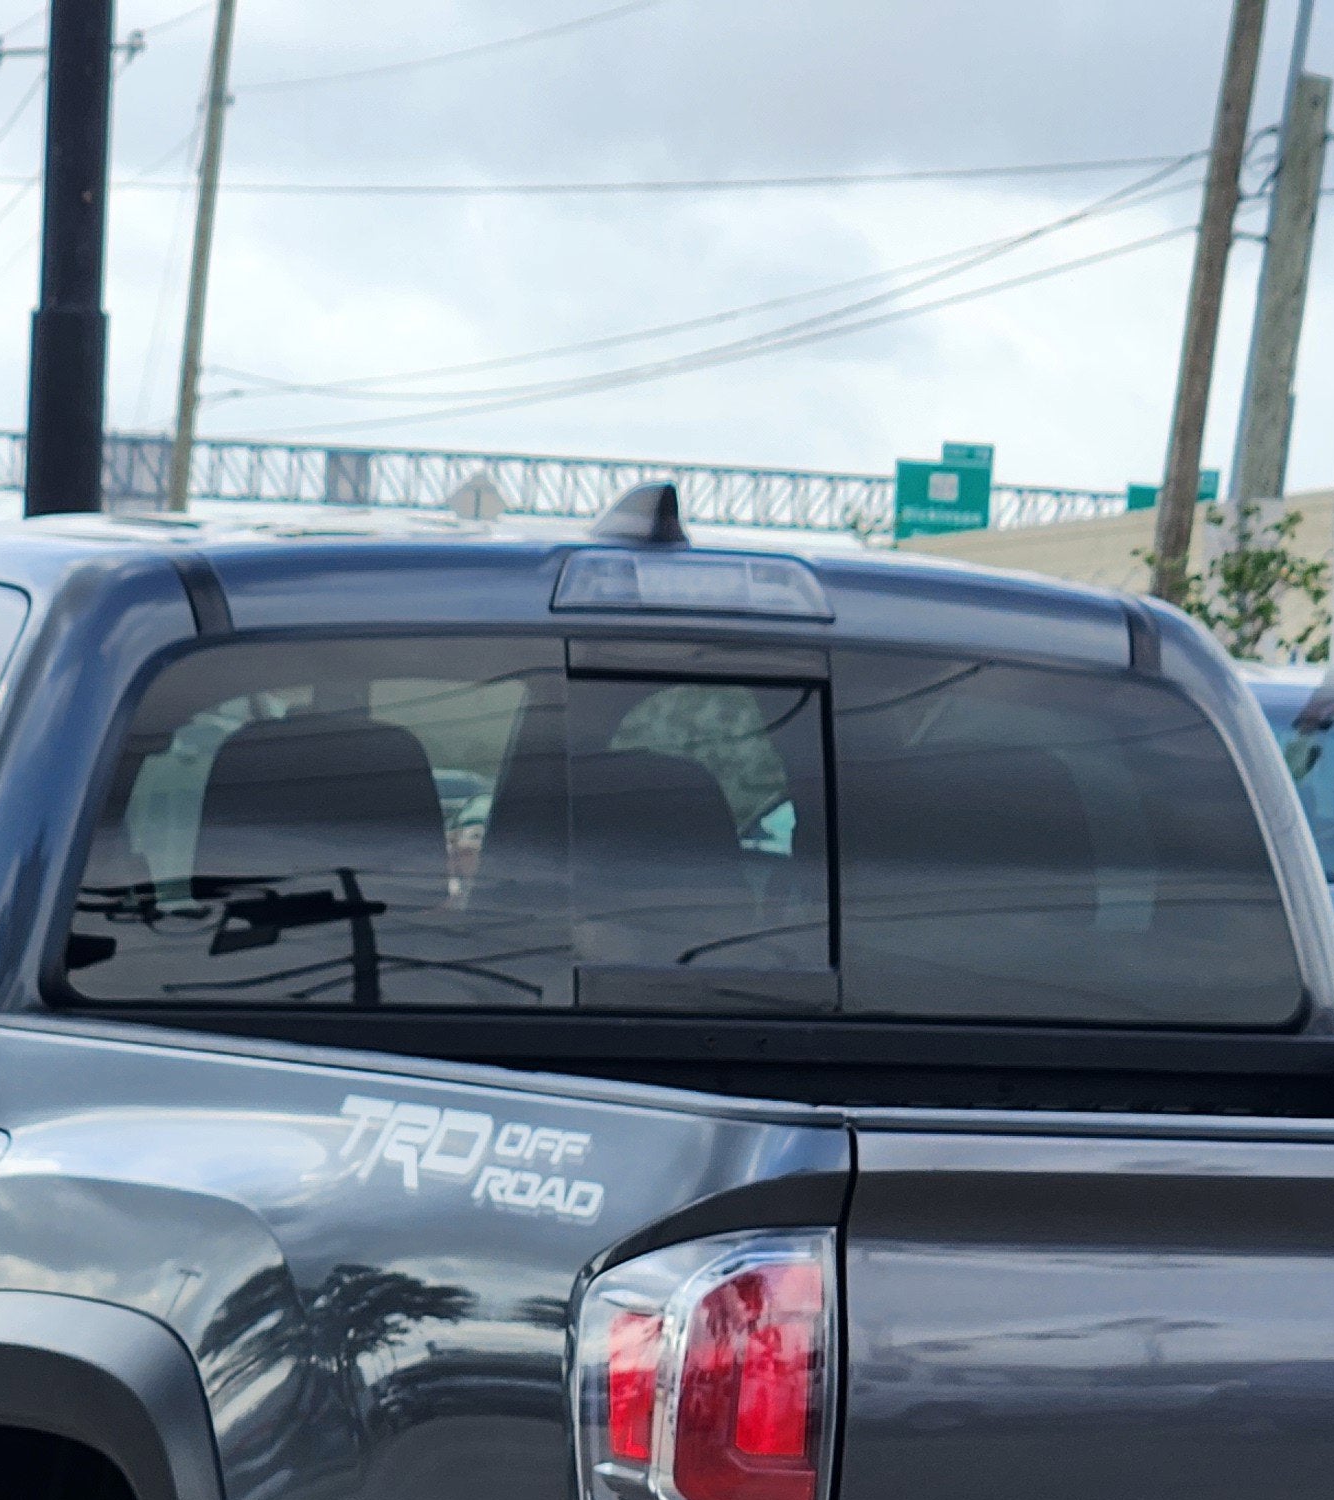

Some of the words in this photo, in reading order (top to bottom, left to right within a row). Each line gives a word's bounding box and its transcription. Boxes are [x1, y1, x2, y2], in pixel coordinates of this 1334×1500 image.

[340, 1093, 494, 1191] TRD
[494, 1121, 593, 1165] OFF
[471, 1165, 605, 1218] ROAD
